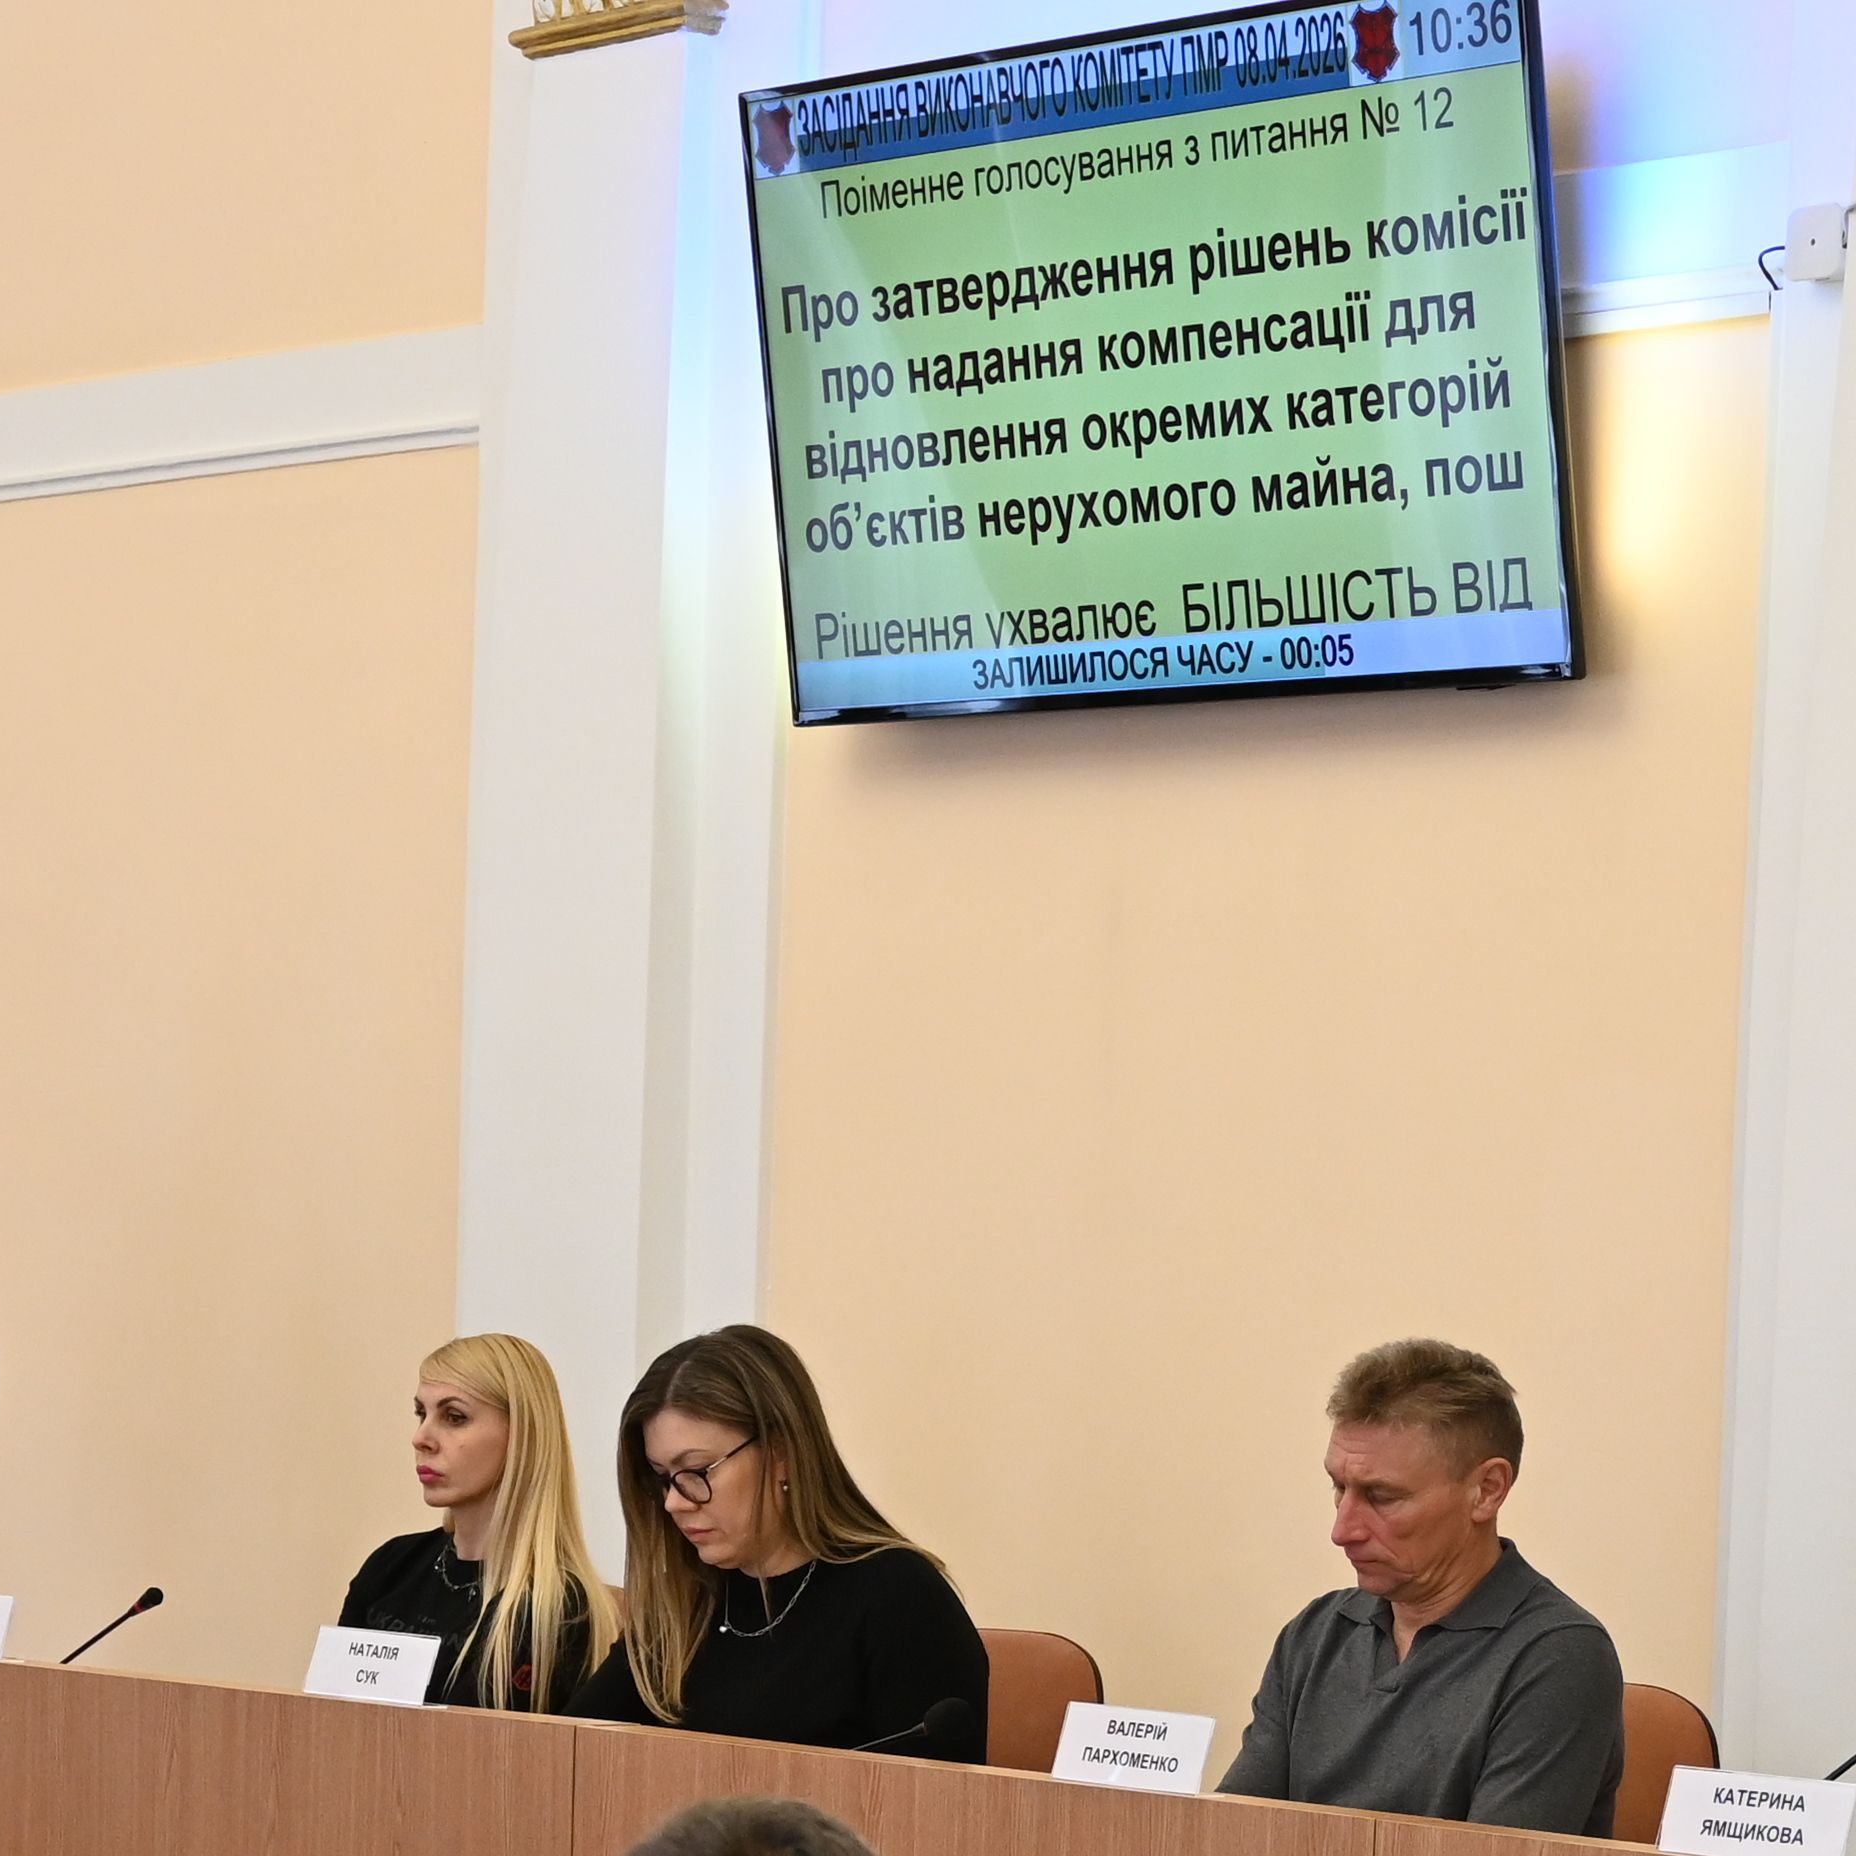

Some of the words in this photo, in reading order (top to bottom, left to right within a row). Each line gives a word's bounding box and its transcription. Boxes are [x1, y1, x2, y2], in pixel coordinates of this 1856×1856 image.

[1408, 0, 1513, 57] 10:36
[798, 93, 910, 161] ЗАСІДАННЯ
[916, 57, 1067, 139] ВИКОНАВЧОГО
[1072, 36, 1175, 115] КОМІТЕТУ
[1180, 29, 1229, 96] ПМР
[1233, 10, 1346, 88] 08.04.2026
[820, 170, 964, 219] Поіменне
[974, 138, 1173, 195] голосування
[1184, 134, 1201, 166] з
[1210, 112, 1349, 162] питання
[1360, 96, 1401, 140] №
[1413, 86, 1455, 132] 12
[781, 284, 860, 343] Про
[870, 247, 1175, 321] затвердження
[1188, 225, 1352, 295] рішень
[1366, 186, 1529, 260] комісії
[821, 361, 895, 414] про
[907, 337, 1084, 397] надання
[1097, 290, 1372, 372] компенсації
[1384, 290, 1477, 349] для
[805, 417, 1068, 485] відновлення
[1081, 394, 1274, 459] окремих
[1285, 355, 1512, 430] категорій
[977, 477, 1237, 546] нерухомого
[1250, 453, 1410, 514] майна,
[1424, 449, 1526, 498] пош
[814, 610, 975, 660] Рішення
[984, 599, 1158, 650] ухвалює
[1181, 566, 1439, 634] БІЛЬШІСТЬ
[1452, 556, 1534, 613] ВІД
[971, 645, 1170, 690] ЗАЛИШИЛОСЯ
[1176, 640, 1254, 677] ЧАСУ
[1279, 633, 1356, 671] 00:05
[348, 1641, 400, 1662] НАТАЛІЯ
[355, 1669, 380, 1686] СУК
[1106, 1719, 1169, 1742] ВАЛЕРІЙ
[1082, 1746, 1179, 1774] ПАРХОМЕНКО
[1713, 1786, 1806, 1813] КАТЕРИНА
[1699, 1818, 1805, 1846] ЯМЩИКОВА
